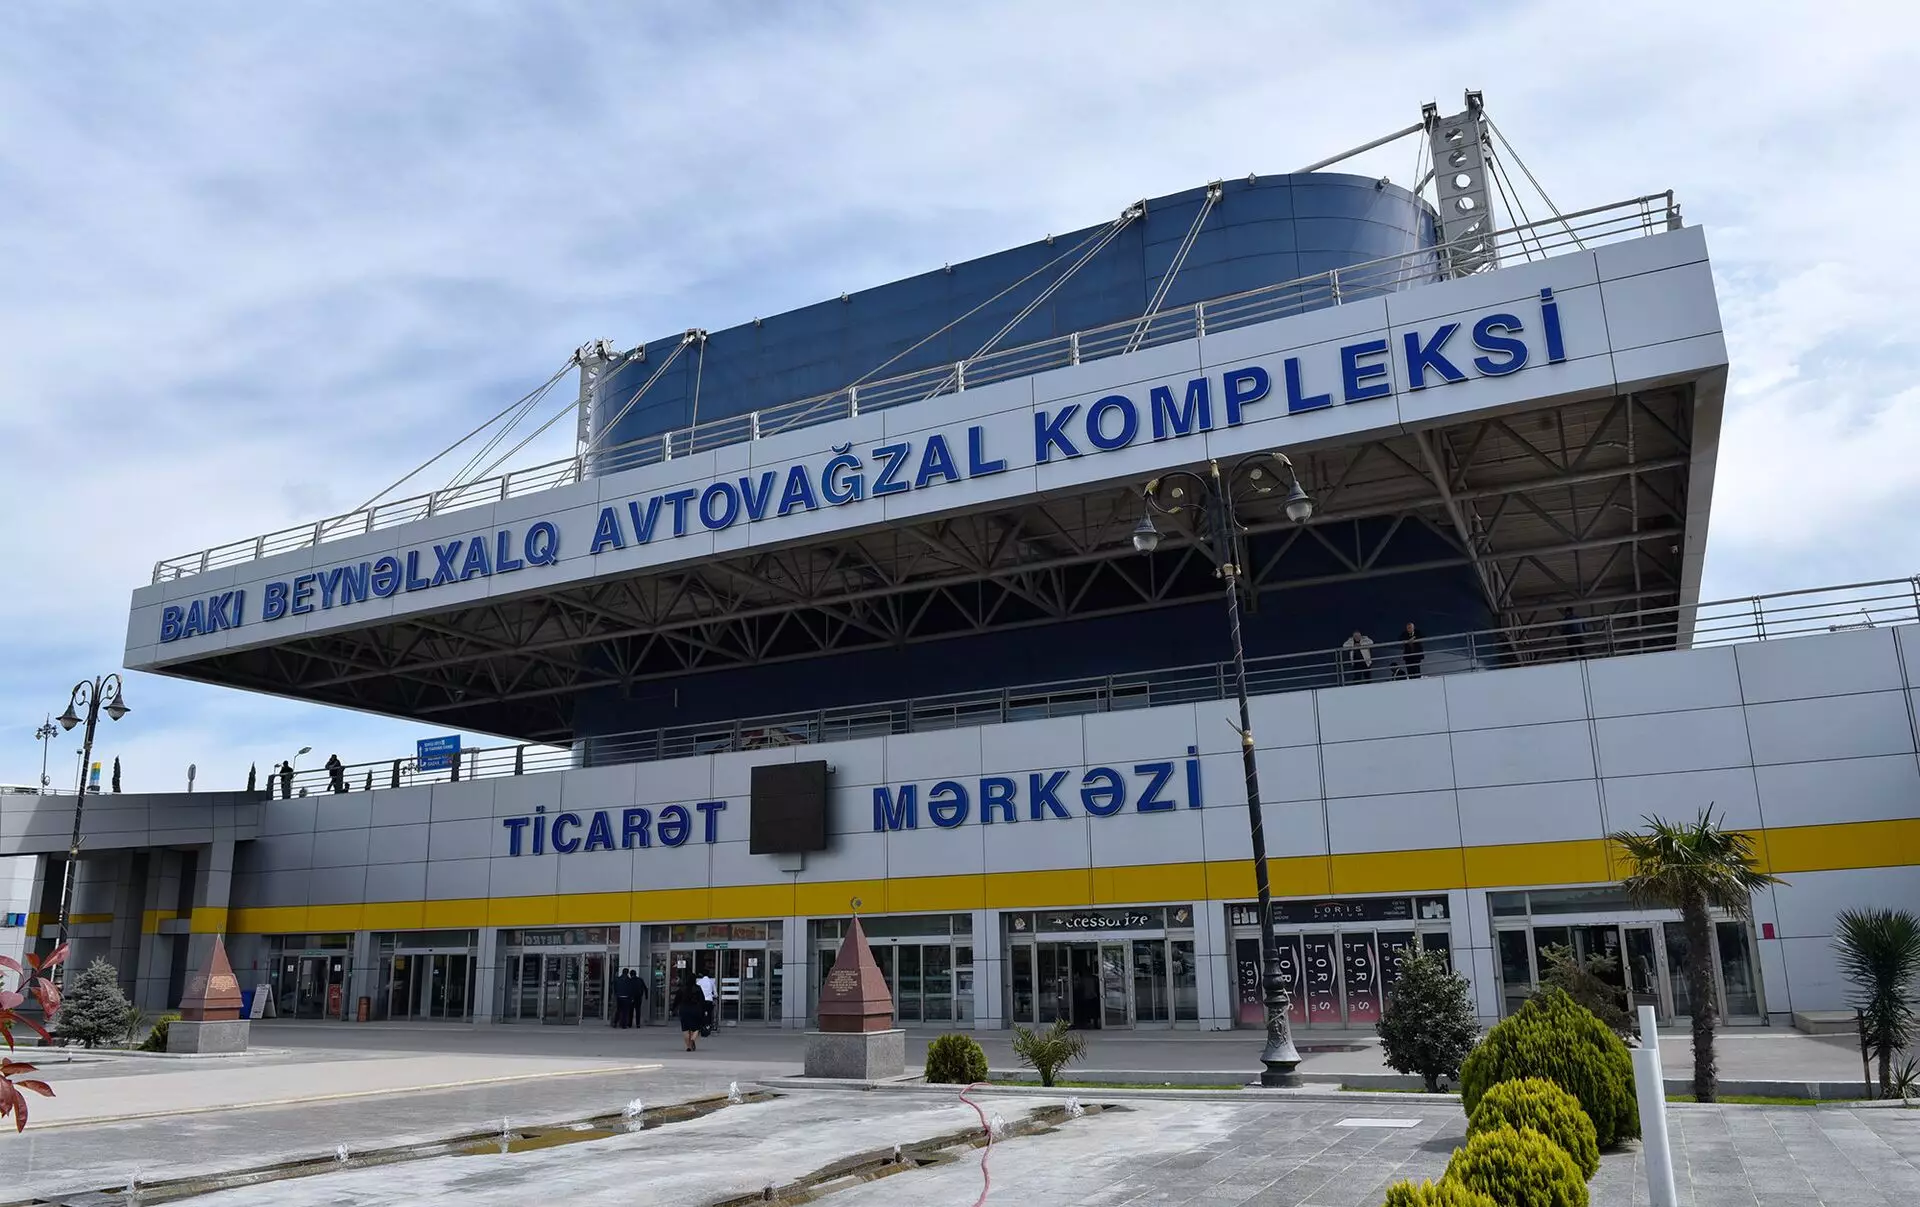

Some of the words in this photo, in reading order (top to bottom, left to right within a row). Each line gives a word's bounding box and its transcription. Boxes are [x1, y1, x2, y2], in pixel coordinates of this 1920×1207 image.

[160, 590, 244, 643] BAKI
[264, 520, 561, 622] BEYNƏLXALQ
[590, 424, 1006, 554] AVTOVAĞZAL
[1034, 287, 1567, 464] KOMPLEKSİ
[502, 799, 727, 857] TİCARƏT
[873, 746, 1206, 833] MƏRKƏZİ
[1314, 906, 1362, 914] LORIS
[1245, 961, 1256, 1002] LORIS
[1305, 943, 1317, 1012] parfum
[1315, 944, 1330, 1010] LORIS
[1344, 943, 1356, 1012] parfum
[1353, 943, 1370, 1010] LORIS
